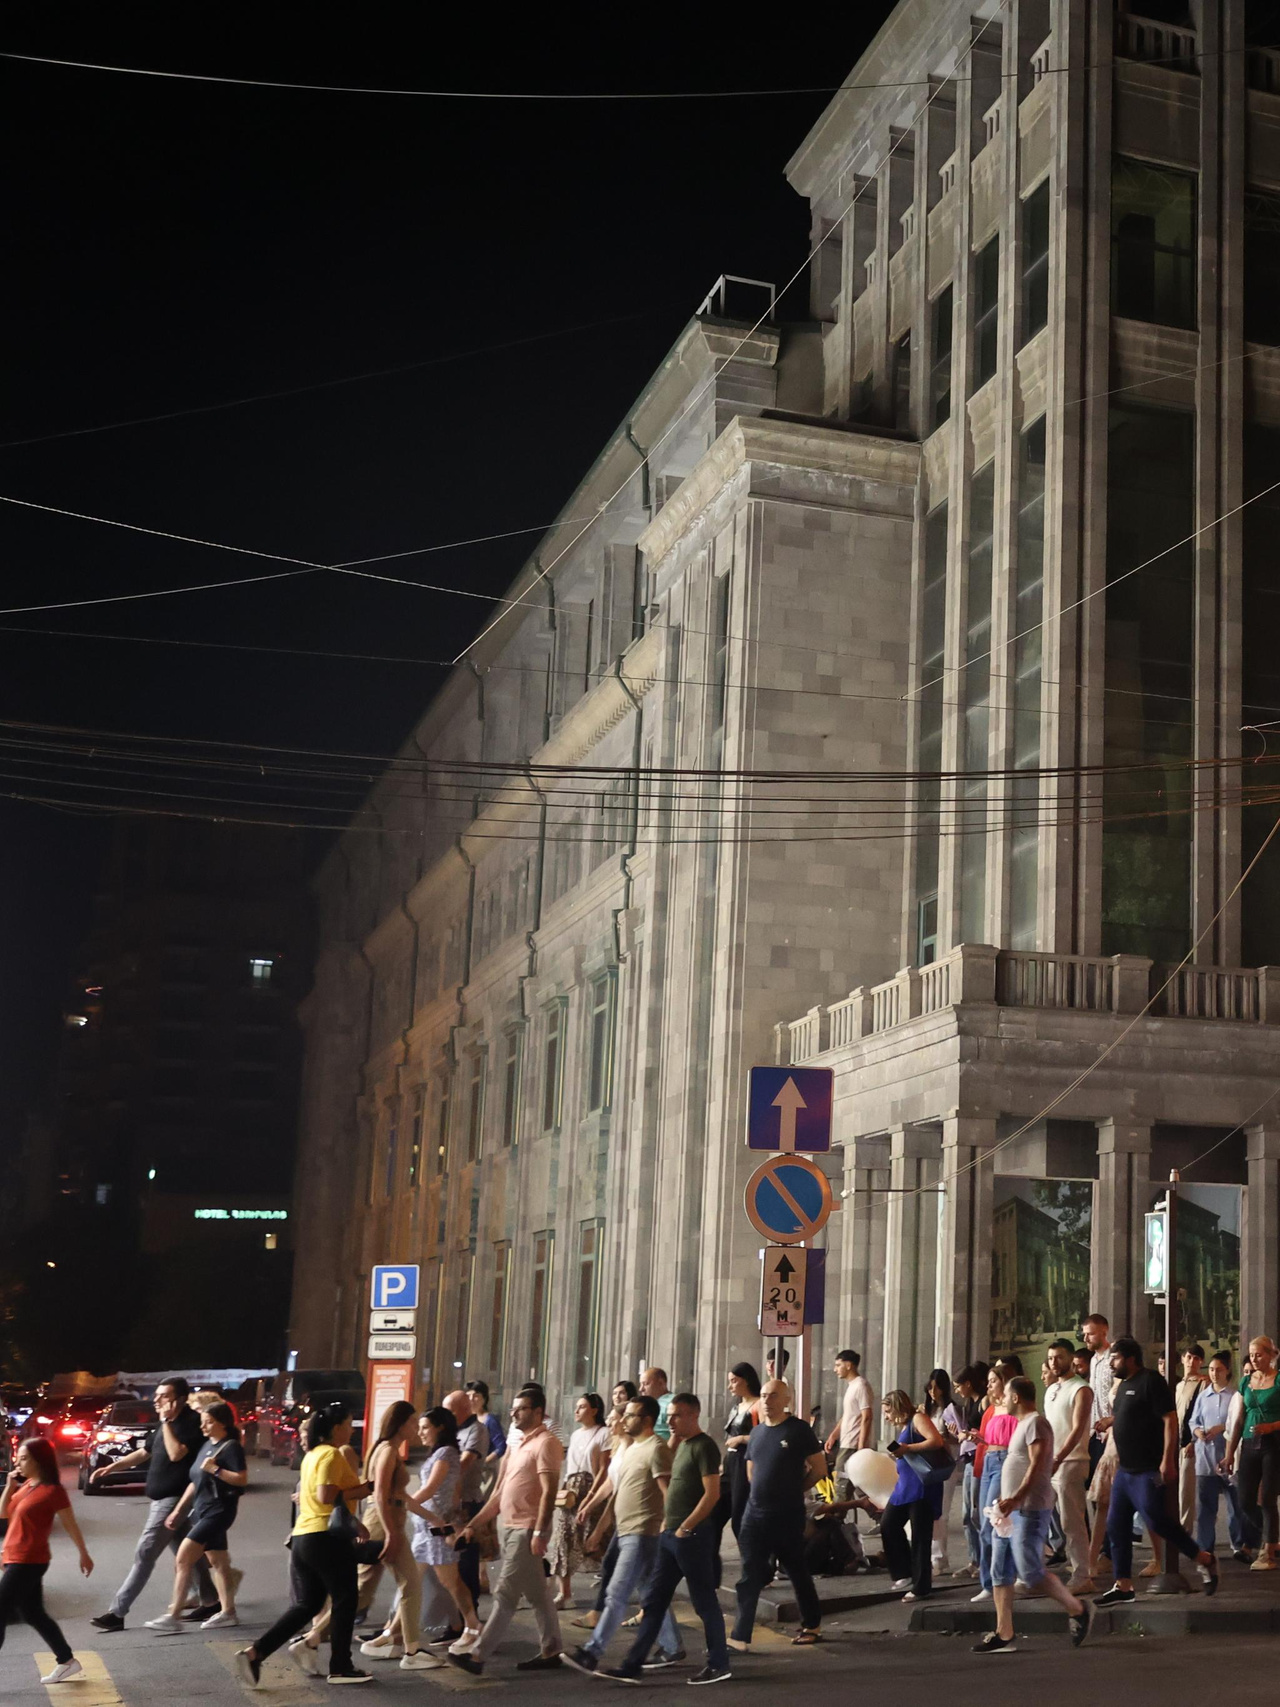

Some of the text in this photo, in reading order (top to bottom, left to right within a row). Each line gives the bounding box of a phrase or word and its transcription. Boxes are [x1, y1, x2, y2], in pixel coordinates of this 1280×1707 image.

[194, 1209, 230, 1219] HOTEL
[380, 1271, 407, 1306] P
[769, 1287, 796, 1303] 20
